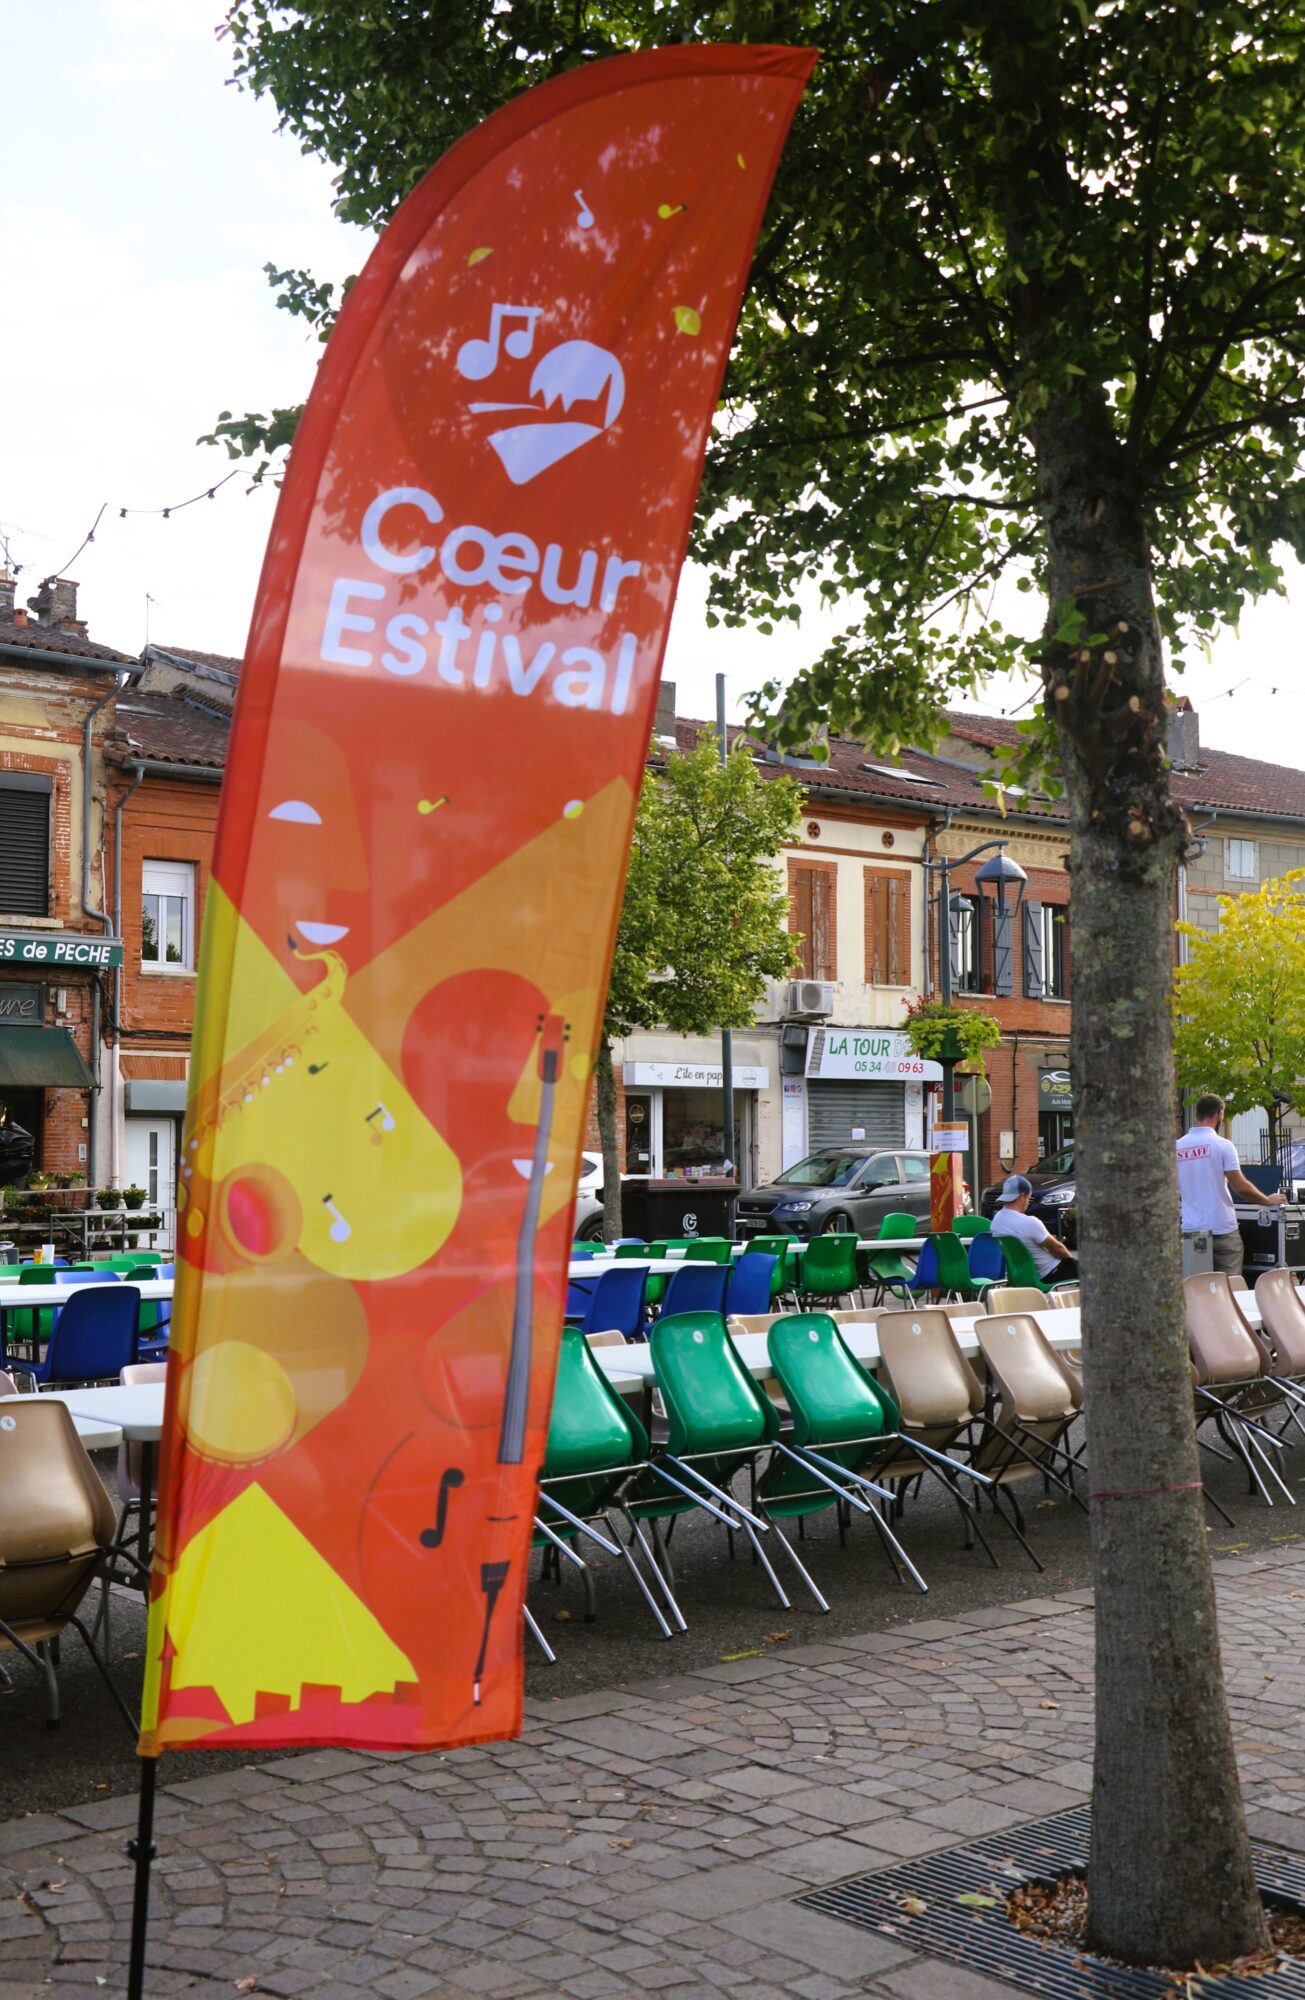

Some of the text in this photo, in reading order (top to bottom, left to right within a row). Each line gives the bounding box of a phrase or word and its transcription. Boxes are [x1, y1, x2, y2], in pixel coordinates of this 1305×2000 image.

[361, 486, 641, 613] Cœur
[320, 577, 638, 716] Estival
[23, 942, 47, 958] de
[54, 943, 111, 963] PECHE
[829, 1037, 848, 1055] LA
[852, 1038, 891, 1057] TOUR
[855, 1061, 867, 1072] 05
[869, 1061, 881, 1073] 34
[898, 1062, 910, 1073] 09
[912, 1063, 924, 1074] 63
[695, 1071, 705, 1080] en
[706, 1072, 724, 1085] pap
[1177, 1145, 1209, 1159] STAFF
